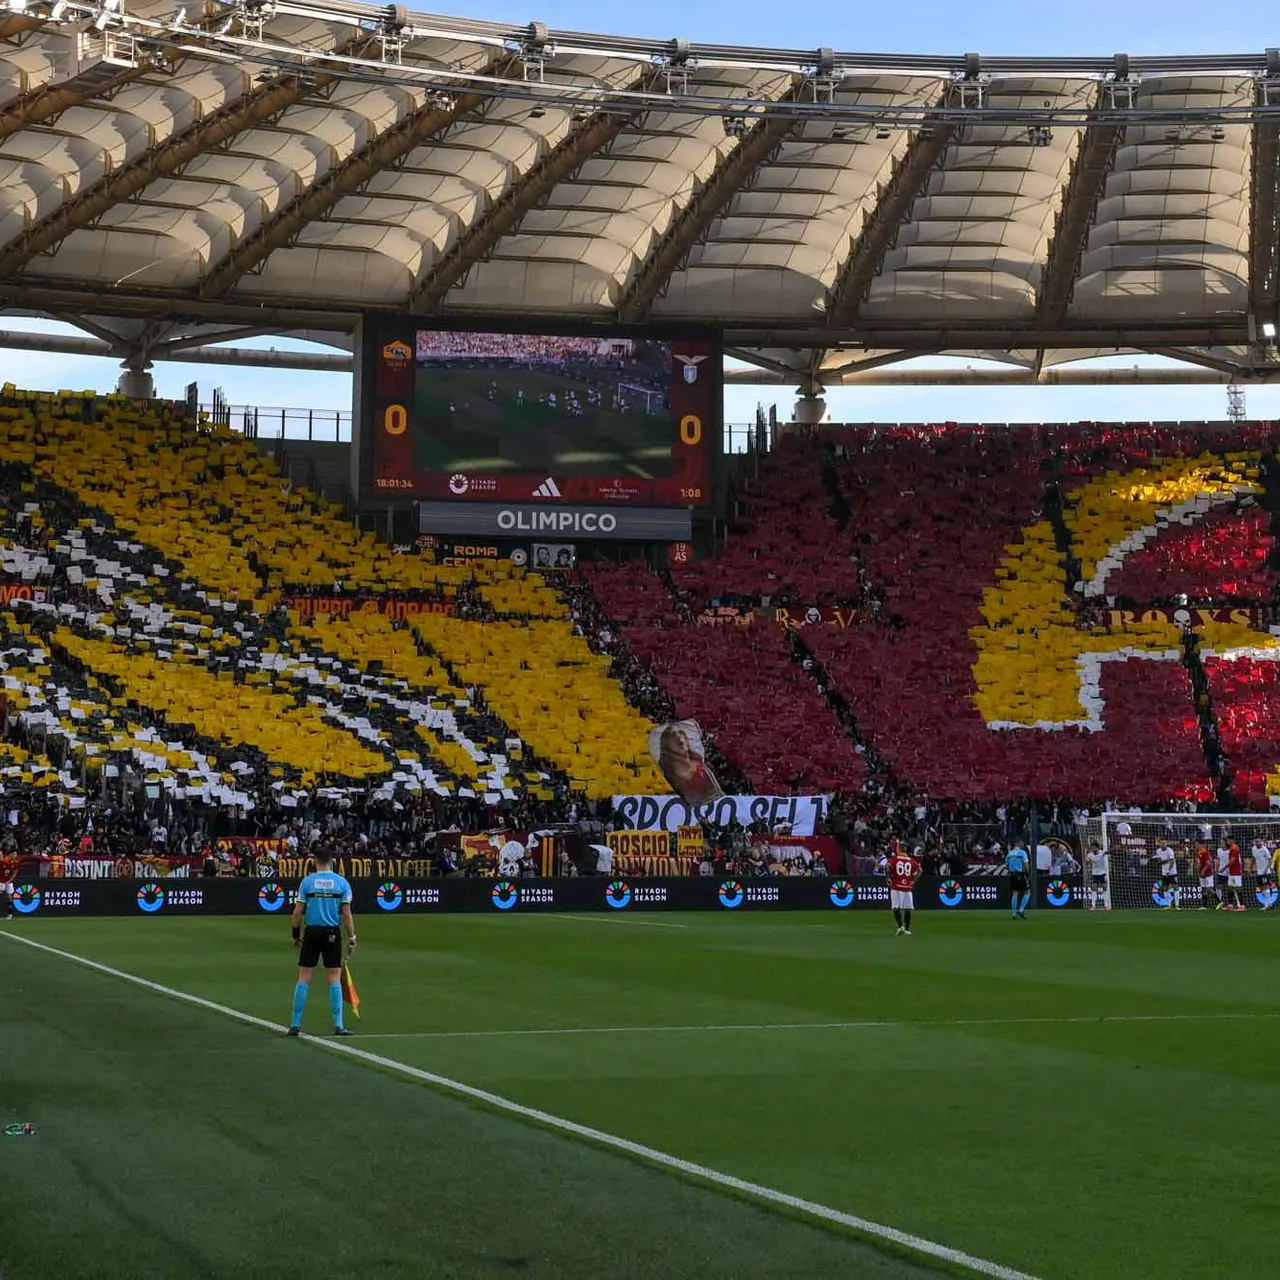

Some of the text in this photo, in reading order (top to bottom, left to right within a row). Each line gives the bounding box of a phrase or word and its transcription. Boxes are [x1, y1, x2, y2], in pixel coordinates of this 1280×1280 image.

[384, 403, 407, 435] 0
[680, 415, 701, 445] 0
[376, 479, 413, 488] 18:01:34
[680, 488, 701, 498] 1:08
[497, 510, 617, 532] OLIMPICO
[454, 545, 498, 556] ROMA
[64, 858, 115, 879] DISTINTI
[278, 857, 346, 878] BRIGA
[896, 861, 911, 876] 69
[44, 891, 80, 899] RIYADH
[634, 894, 667, 902] SEASON
